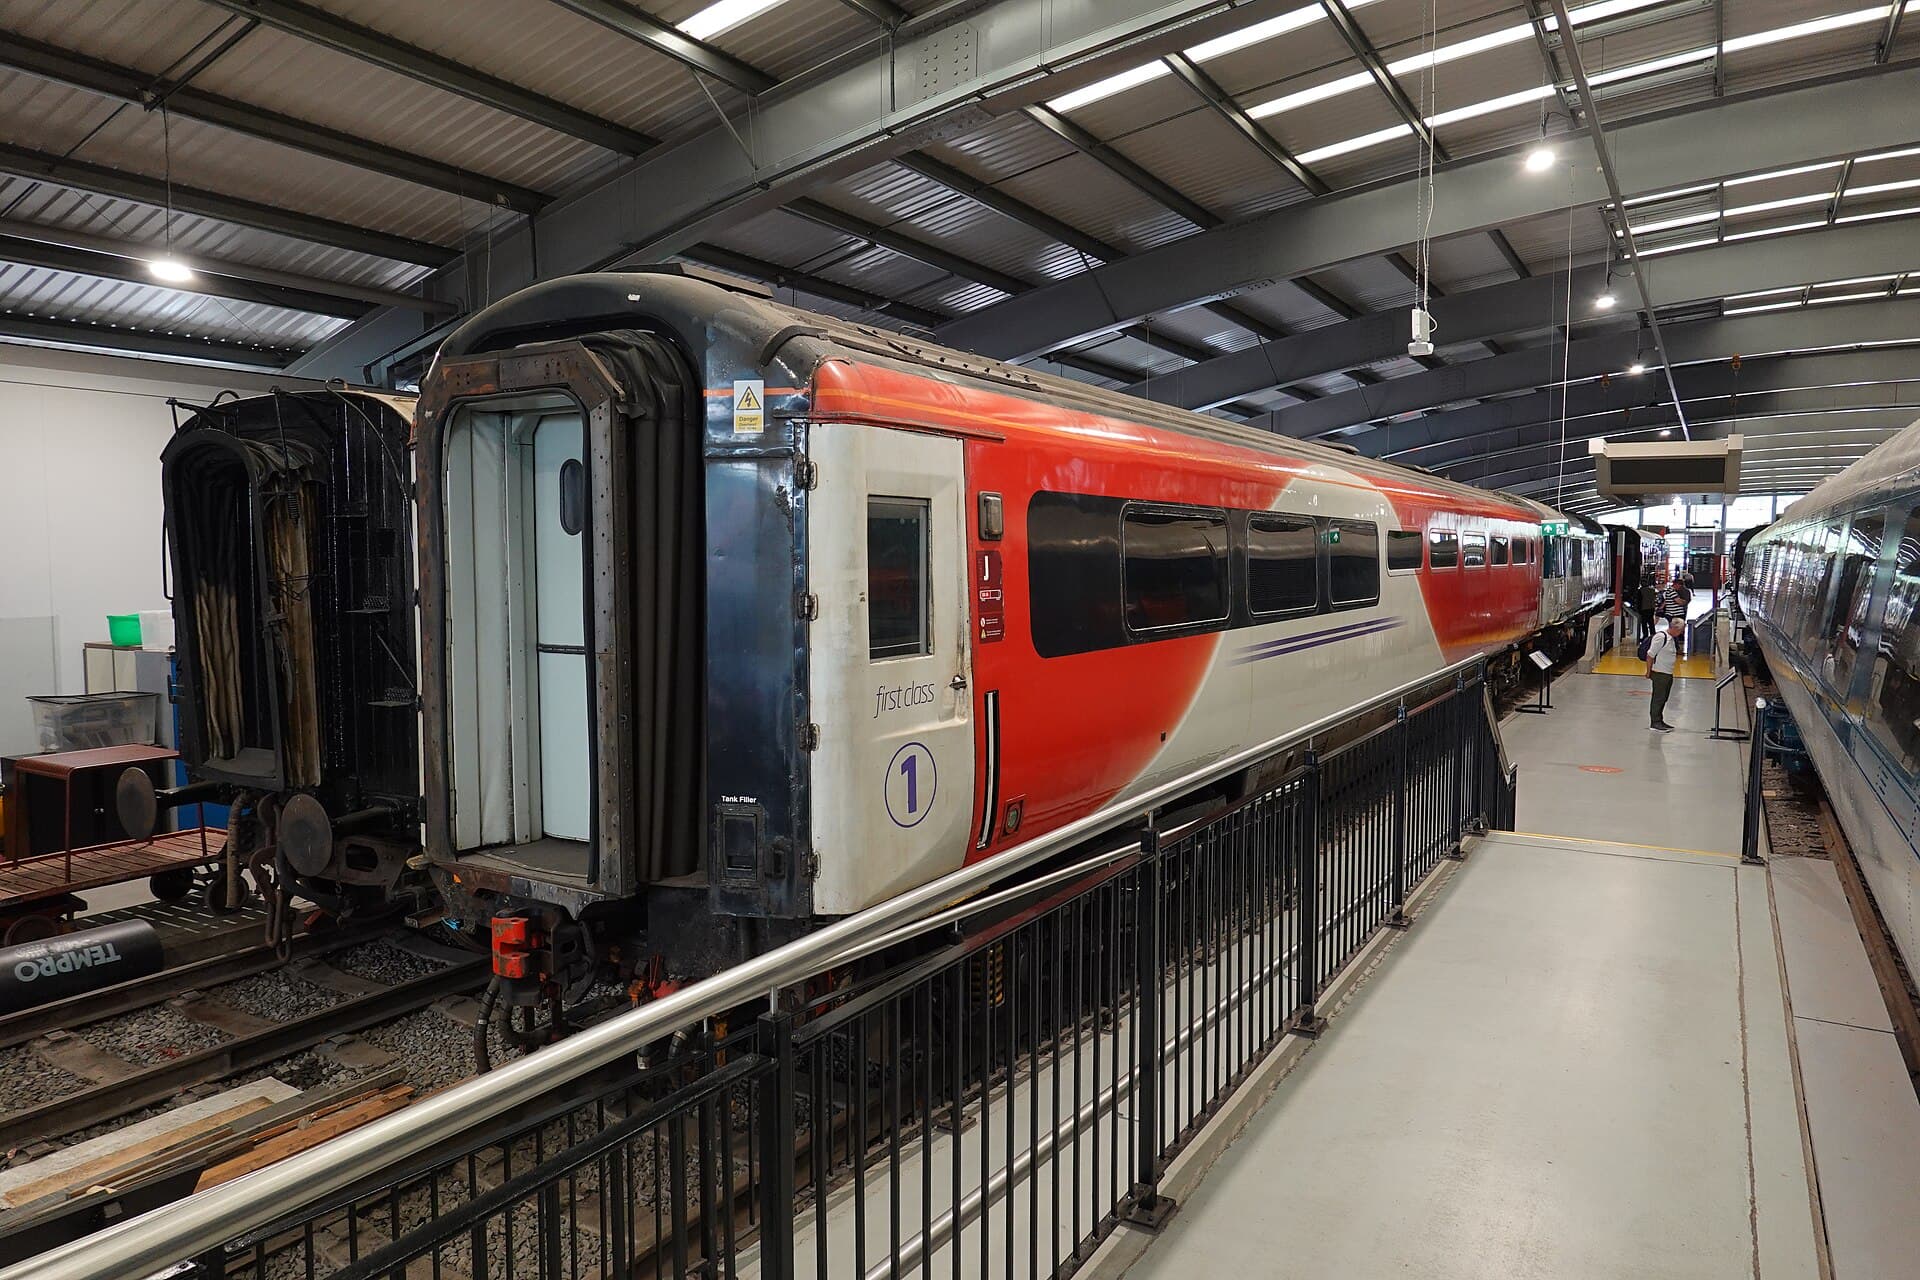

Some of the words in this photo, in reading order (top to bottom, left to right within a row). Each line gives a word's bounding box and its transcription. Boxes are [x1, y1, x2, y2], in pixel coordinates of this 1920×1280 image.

[873, 685, 902, 718] first
[904, 680, 935, 707] class
[721, 795, 738, 803] Tank
[739, 796, 757, 804] Filler
[901, 754, 917, 814] 1
[14, 942, 122, 982] TEMPRO
